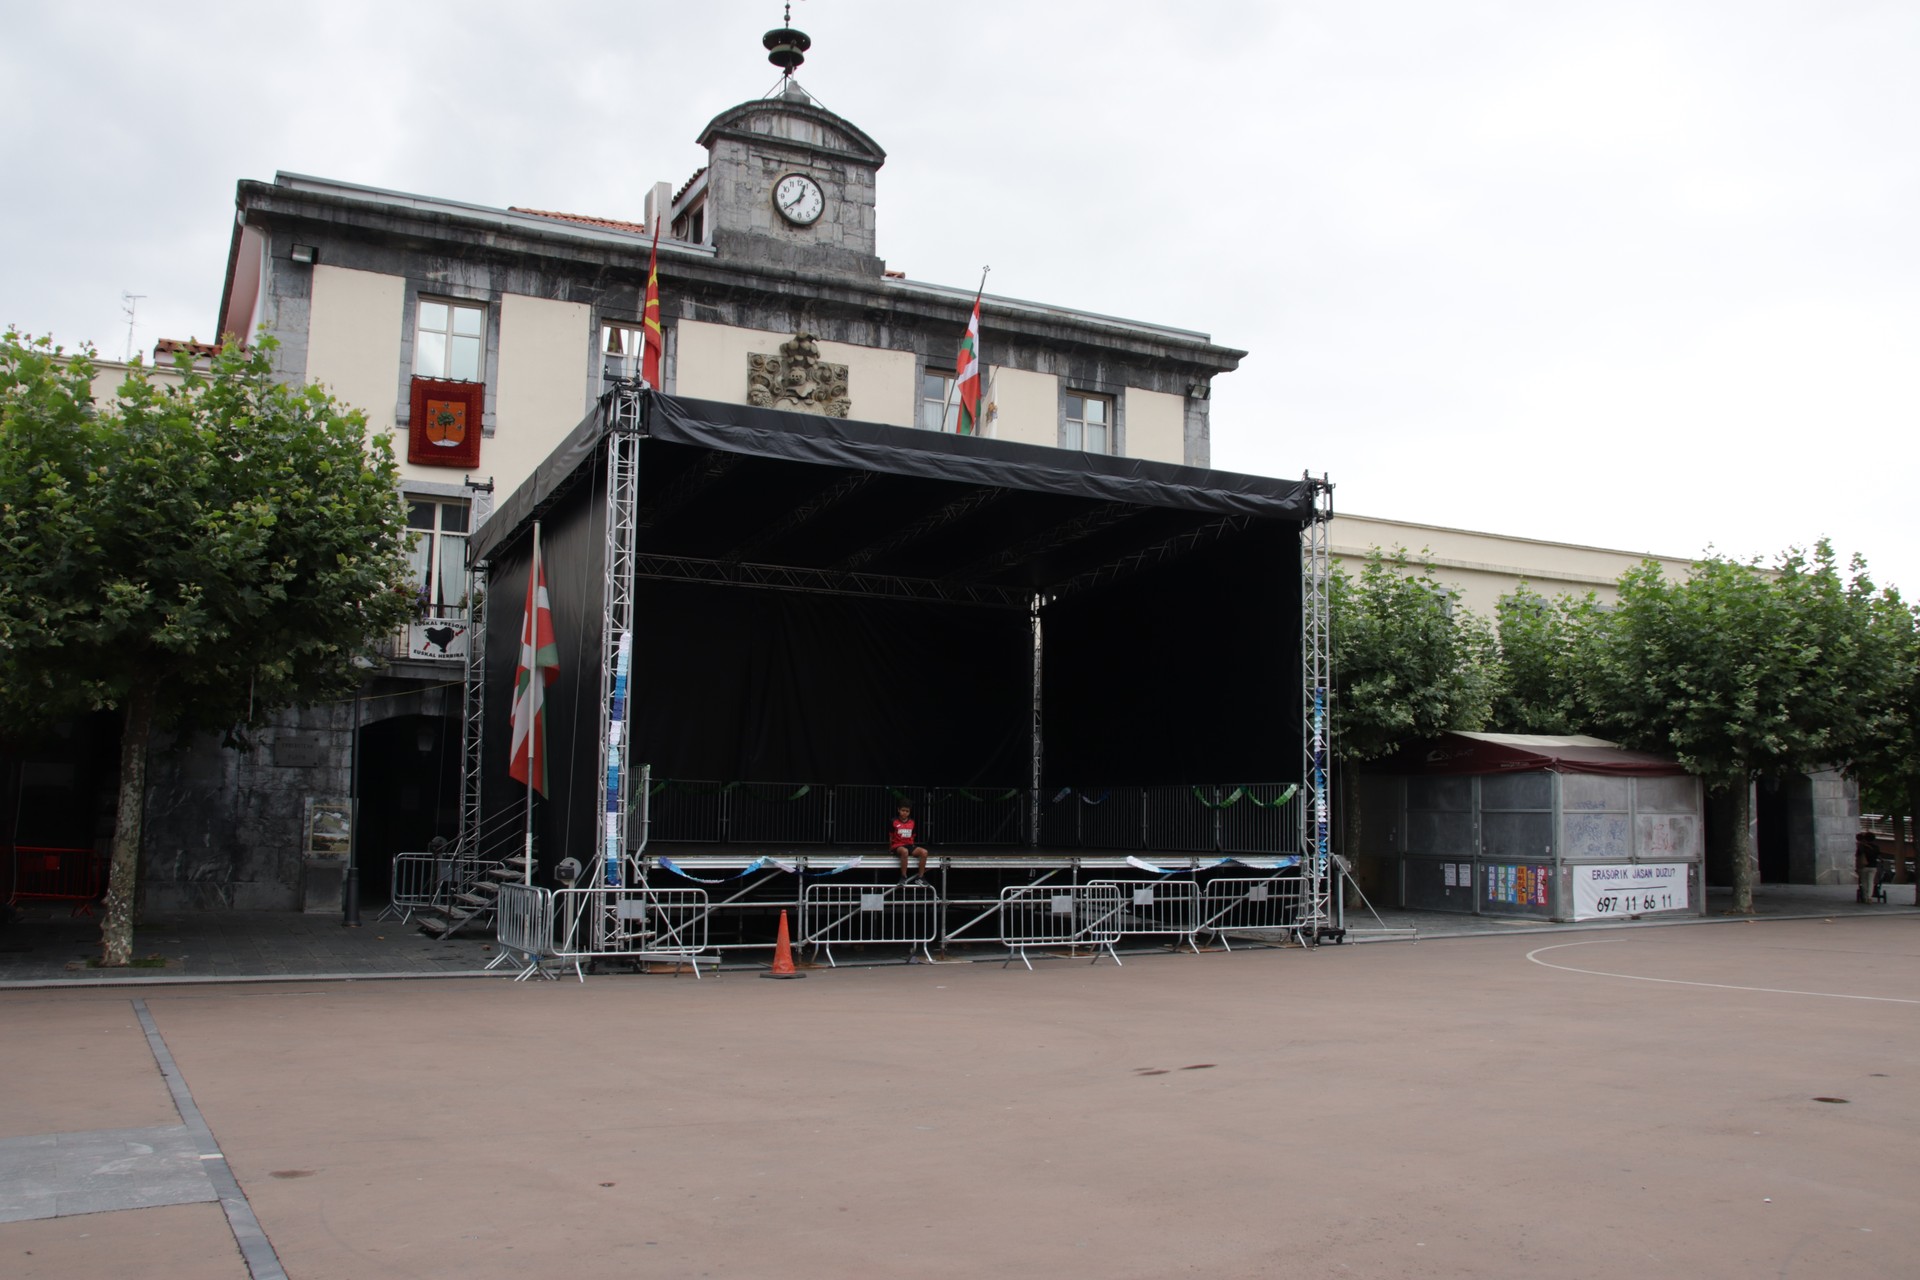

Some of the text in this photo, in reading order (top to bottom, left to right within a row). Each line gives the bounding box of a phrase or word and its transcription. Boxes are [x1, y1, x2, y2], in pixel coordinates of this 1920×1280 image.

[414, 649, 436, 657] EUSKAL
[1592, 867, 1676, 880] ERASORIK JASAN DUZU?
[1597, 894, 1672, 912] 697 11 66 11
